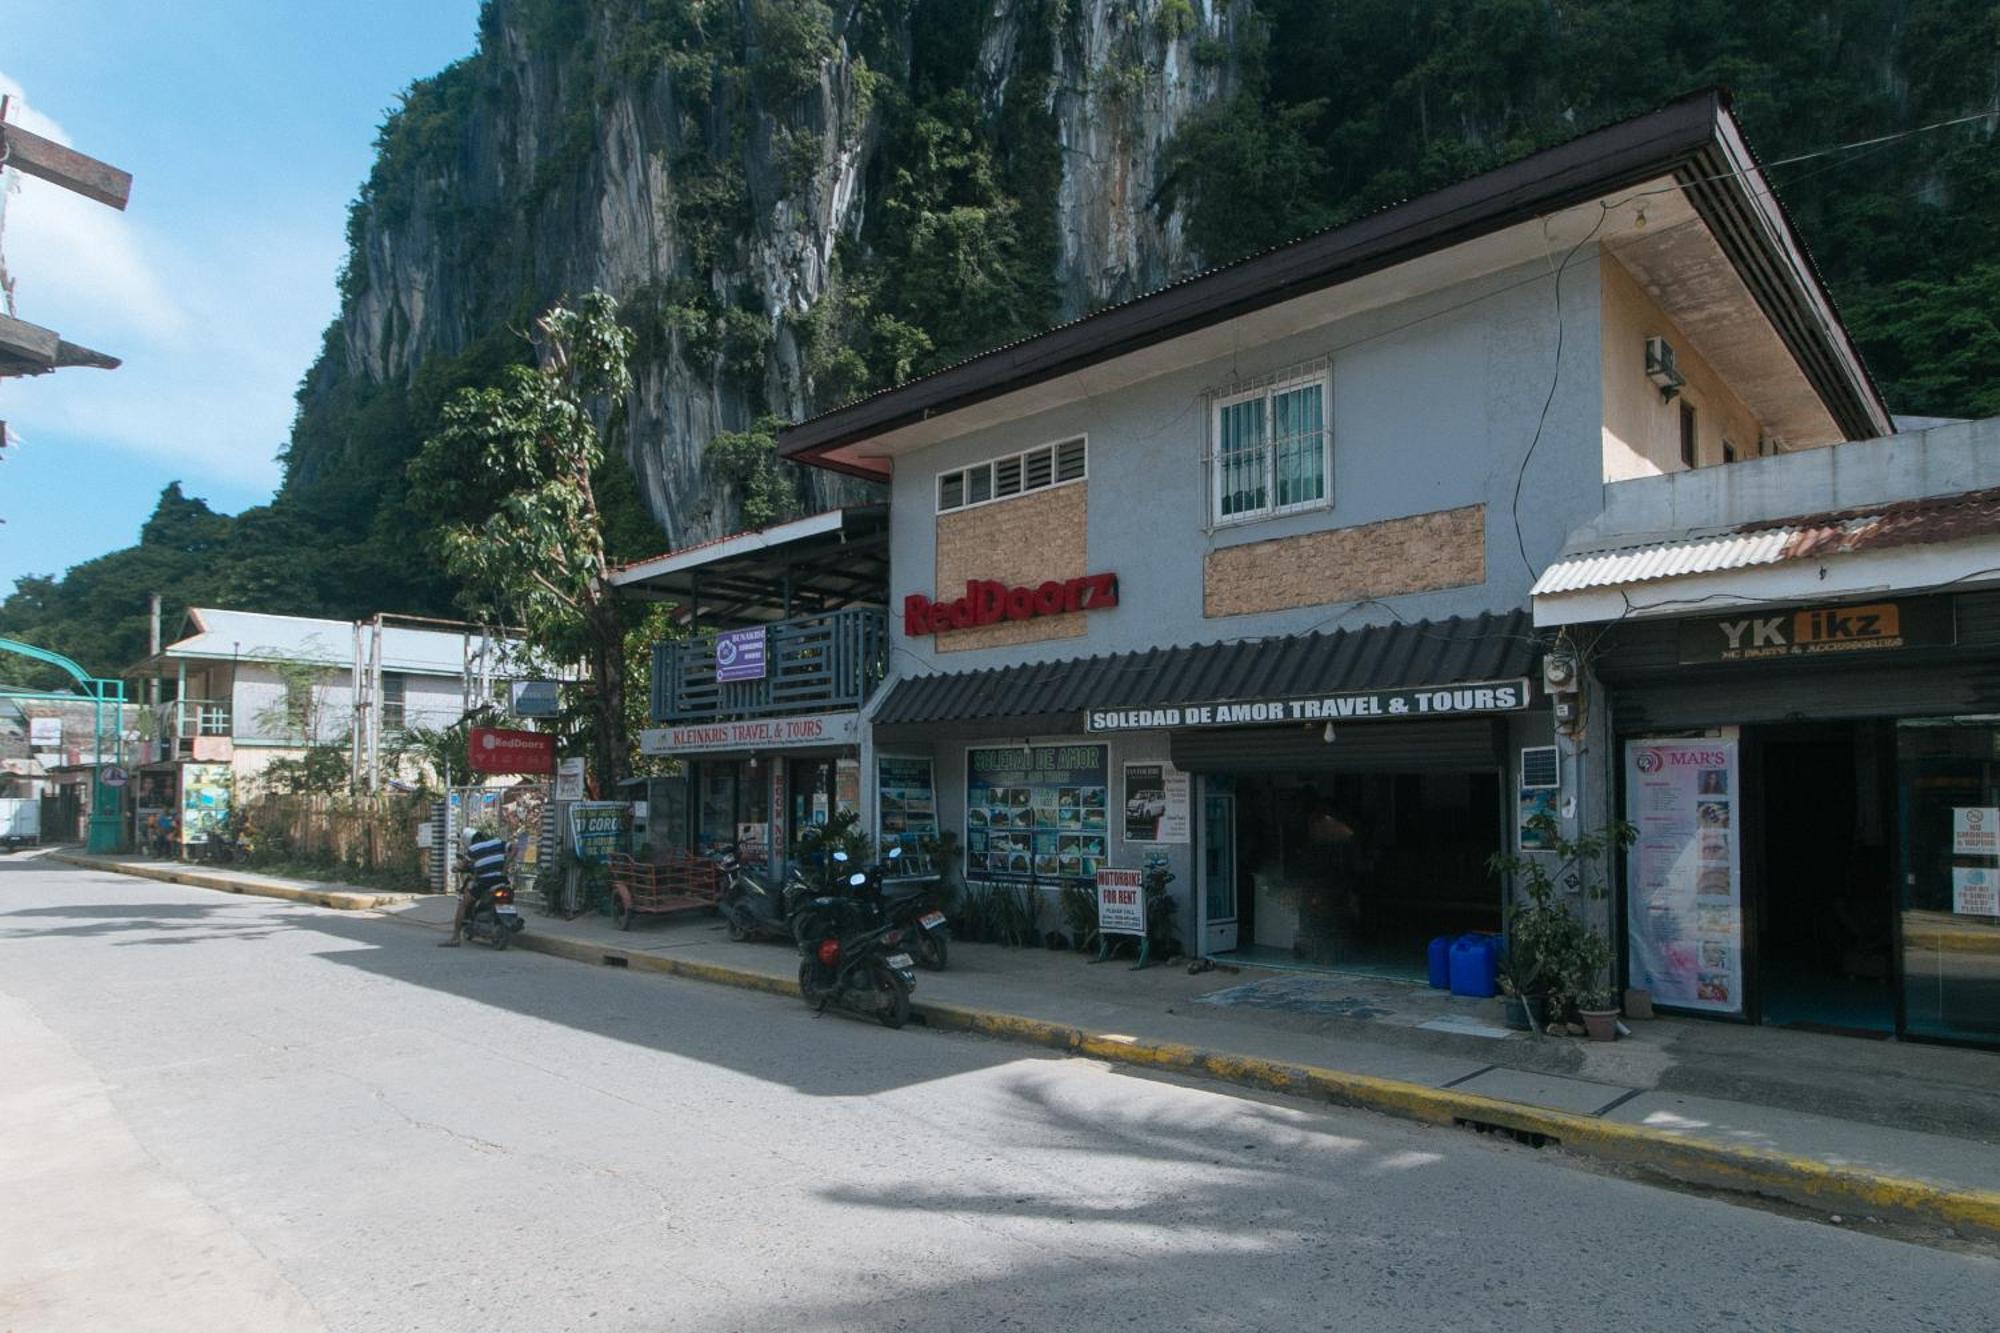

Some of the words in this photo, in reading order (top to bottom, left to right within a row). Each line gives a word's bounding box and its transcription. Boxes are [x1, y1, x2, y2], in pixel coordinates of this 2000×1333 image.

[904, 572, 1119, 637] RedDoorz
[1718, 617, 1787, 649] YK
[1811, 612, 1882, 640] ikz
[1093, 708, 1180, 729] SOLEDAD
[1185, 706, 1212, 724] DE
[1216, 702, 1284, 722] AMOR
[1289, 696, 1382, 718] TRAVEL
[1388, 697, 1409, 713] &
[1415, 687, 1516, 712] TOURS
[673, 726, 729, 745] KLEINKRIS
[731, 721, 770, 741] TRAVEL
[774, 723, 783, 738] &
[787, 719, 824, 738] TOURS
[496, 737, 545, 749] RedDoorz
[974, 749, 1032, 771] SOLEDAD
[1035, 748, 1056, 770] DE
[1057, 746, 1100, 769] AMOR
[1670, 751, 1726, 766] MAR'S
[589, 816, 625, 832] CORO
[1097, 871, 1142, 886] MOTORBIKE
[1104, 889, 1116, 904] FOR
[1119, 890, 1136, 905] RENT
